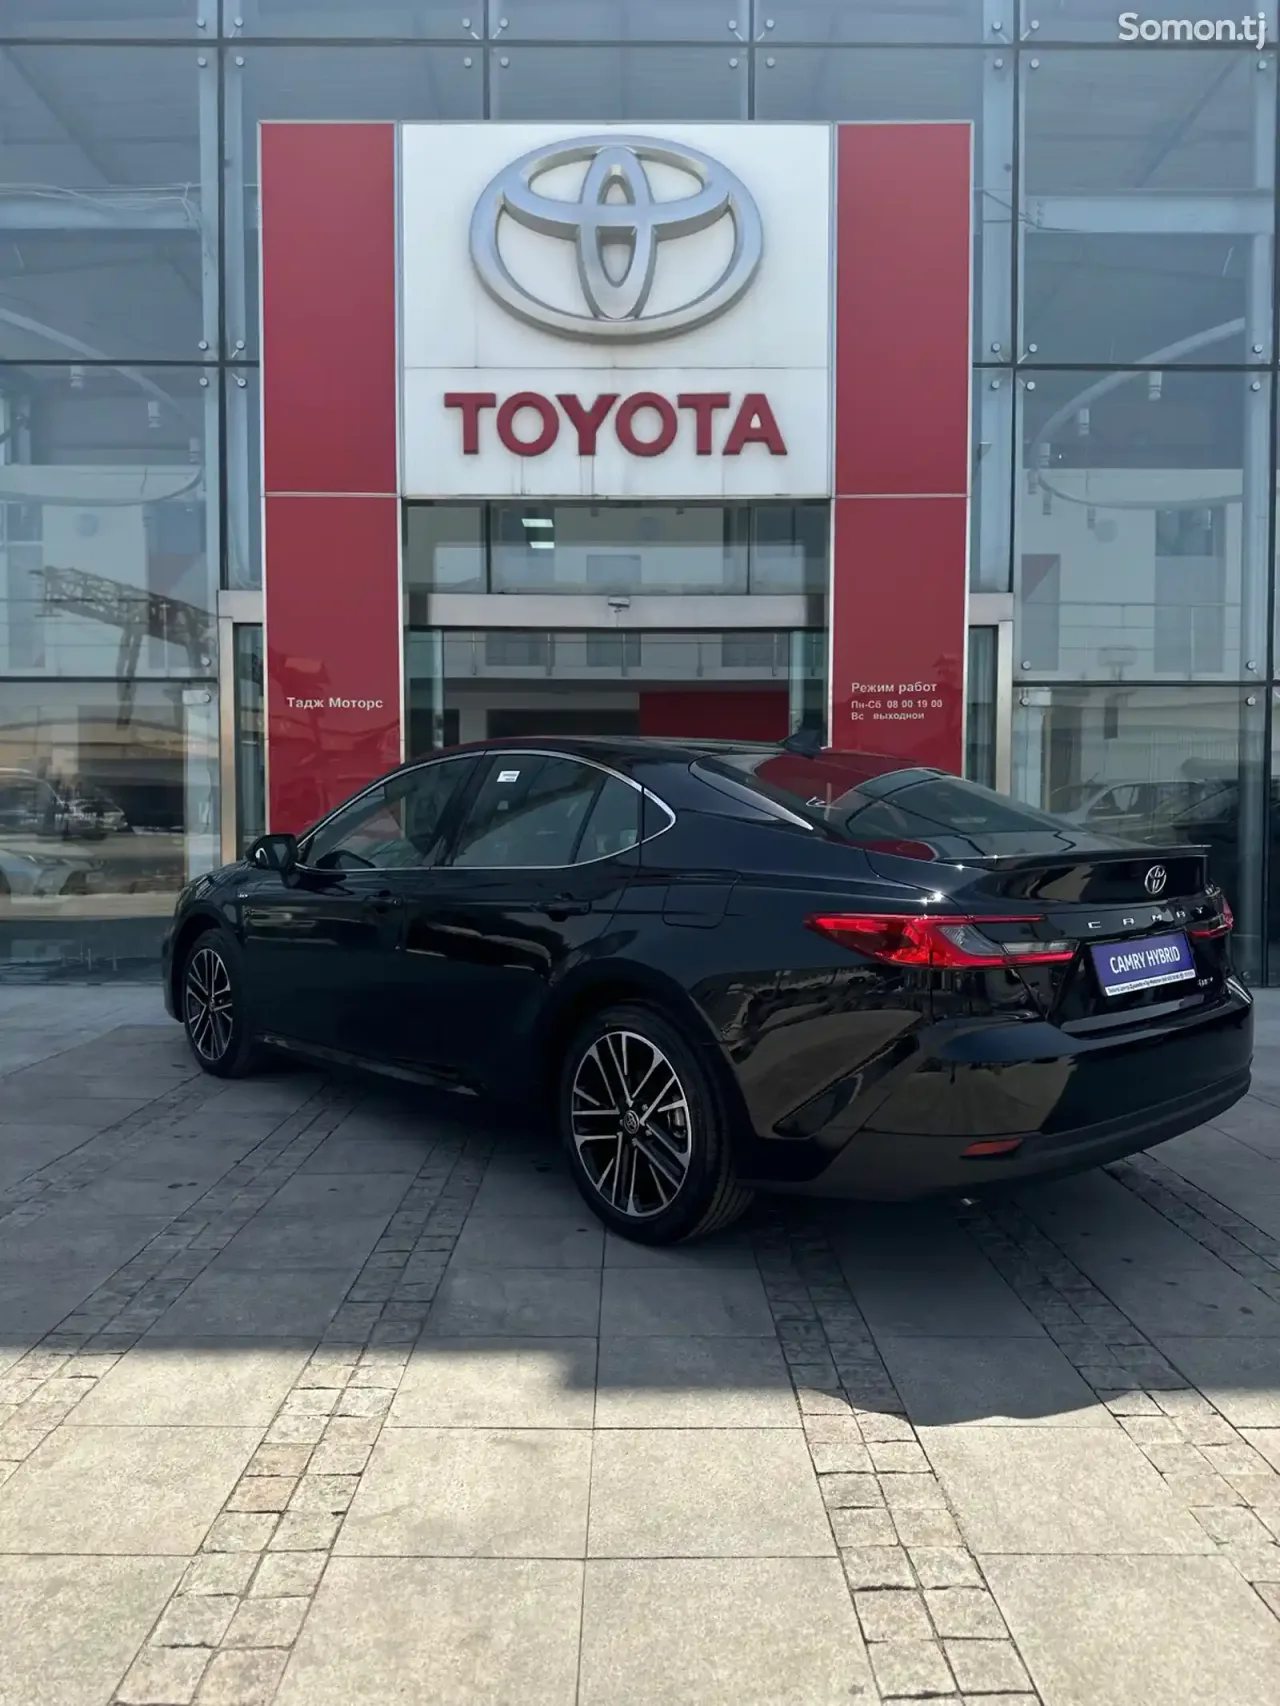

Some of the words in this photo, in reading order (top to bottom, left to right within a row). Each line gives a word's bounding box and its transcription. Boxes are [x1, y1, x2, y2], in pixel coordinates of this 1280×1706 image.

[444, 391, 788, 456] TOYOTA
[851, 682, 895, 693] Режим
[286, 697, 324, 709] Тадж
[329, 697, 384, 711] Моторс
[851, 700, 882, 709] Пн-Сб
[851, 712, 864, 720] Вс
[1088, 907, 1203, 929] CAMRY
[1110, 951, 1146, 974] CAMRY
[1145, 946, 1181, 967] HYBRID
